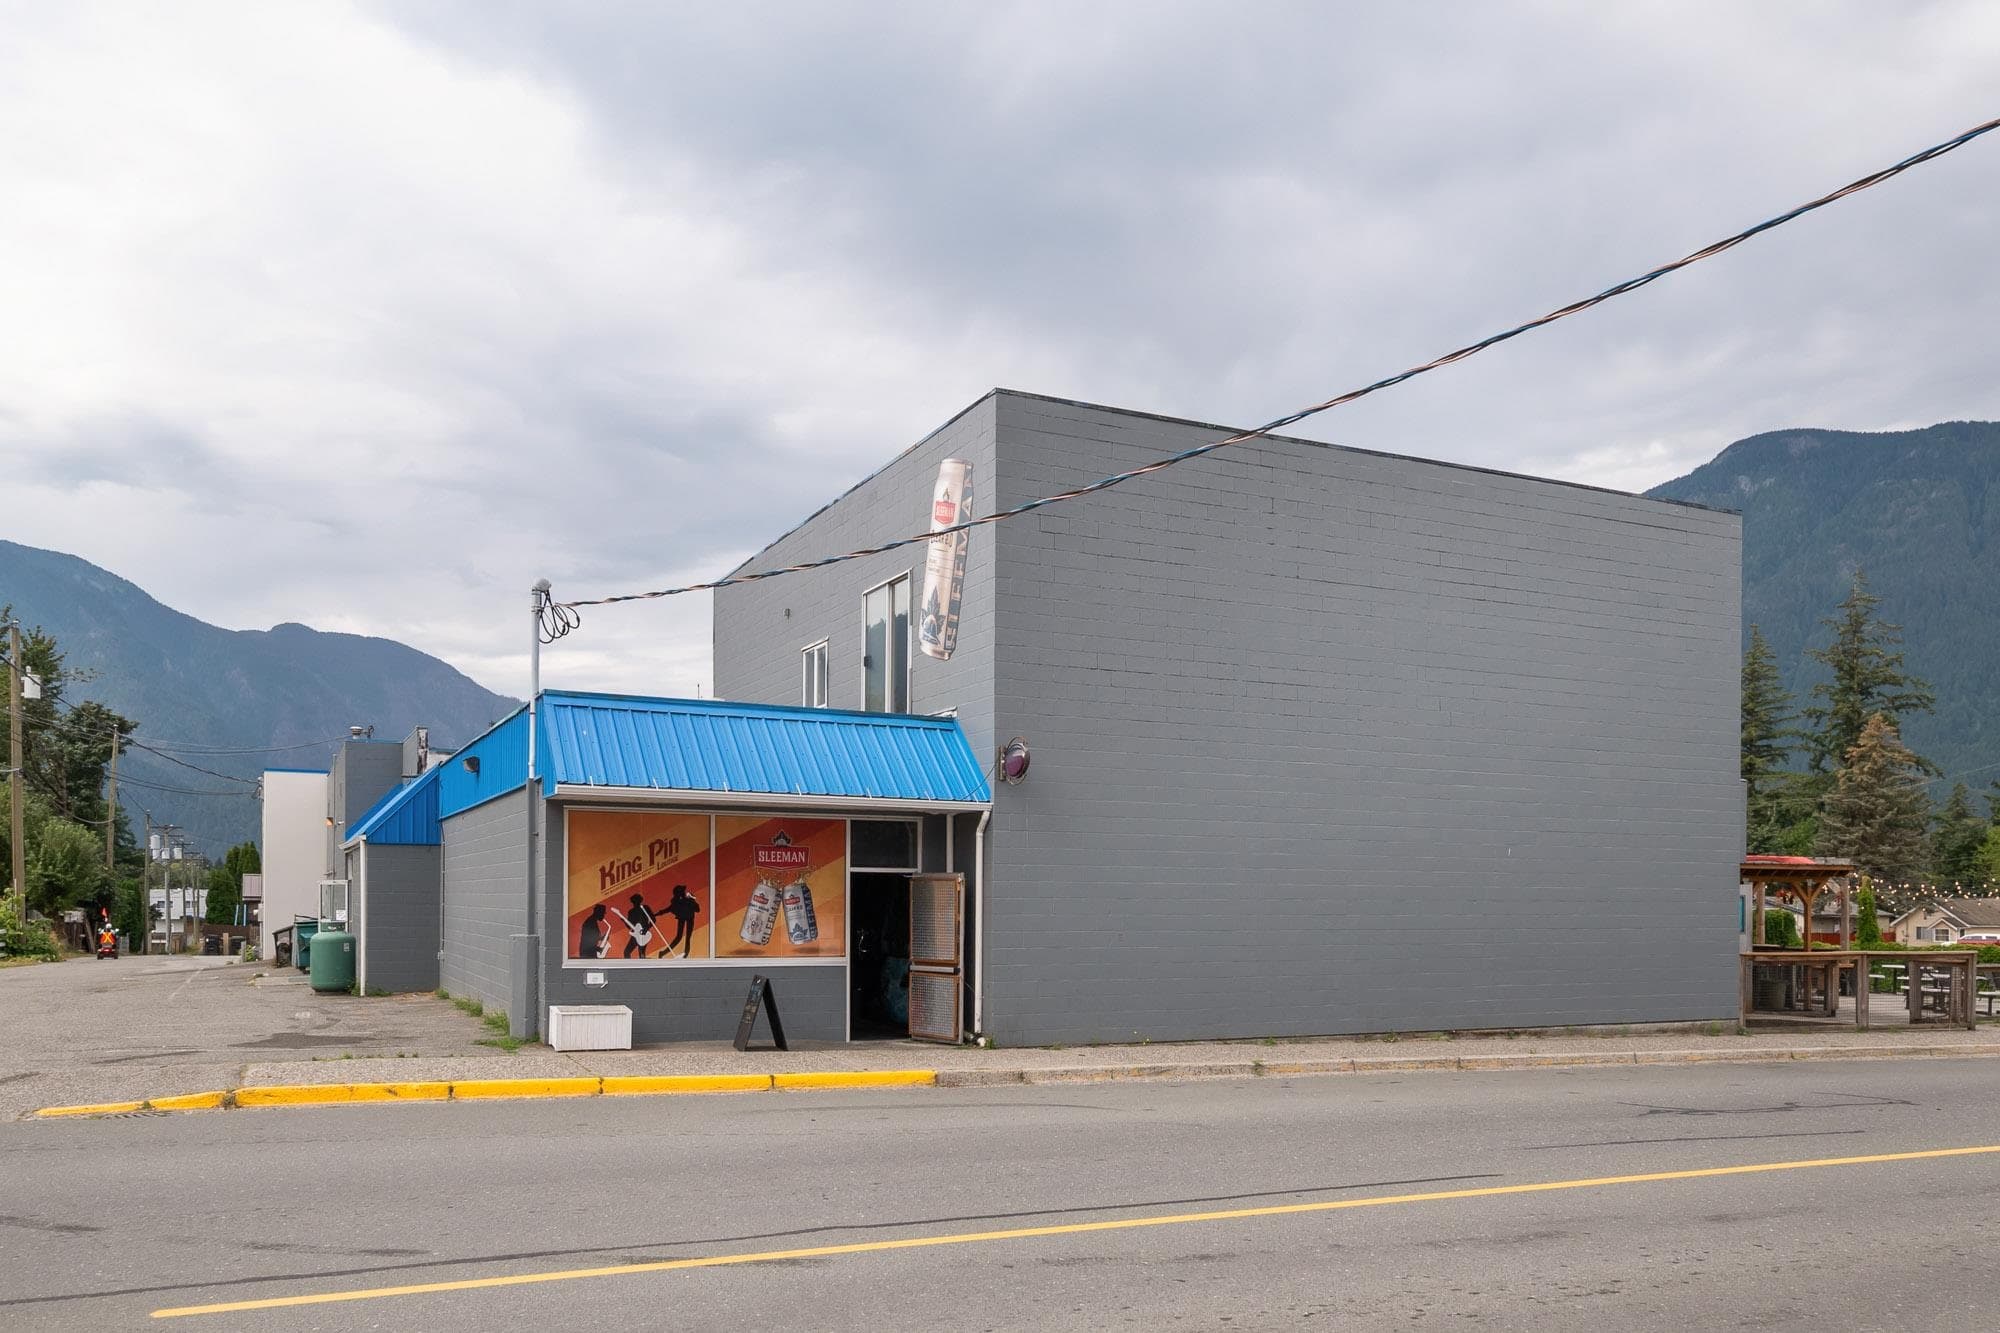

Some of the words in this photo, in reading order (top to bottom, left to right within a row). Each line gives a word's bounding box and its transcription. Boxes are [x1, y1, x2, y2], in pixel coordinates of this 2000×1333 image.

[599, 856, 642, 890] King
[648, 838, 679, 866] Pin
[758, 850, 806, 863] SLEEMAN
